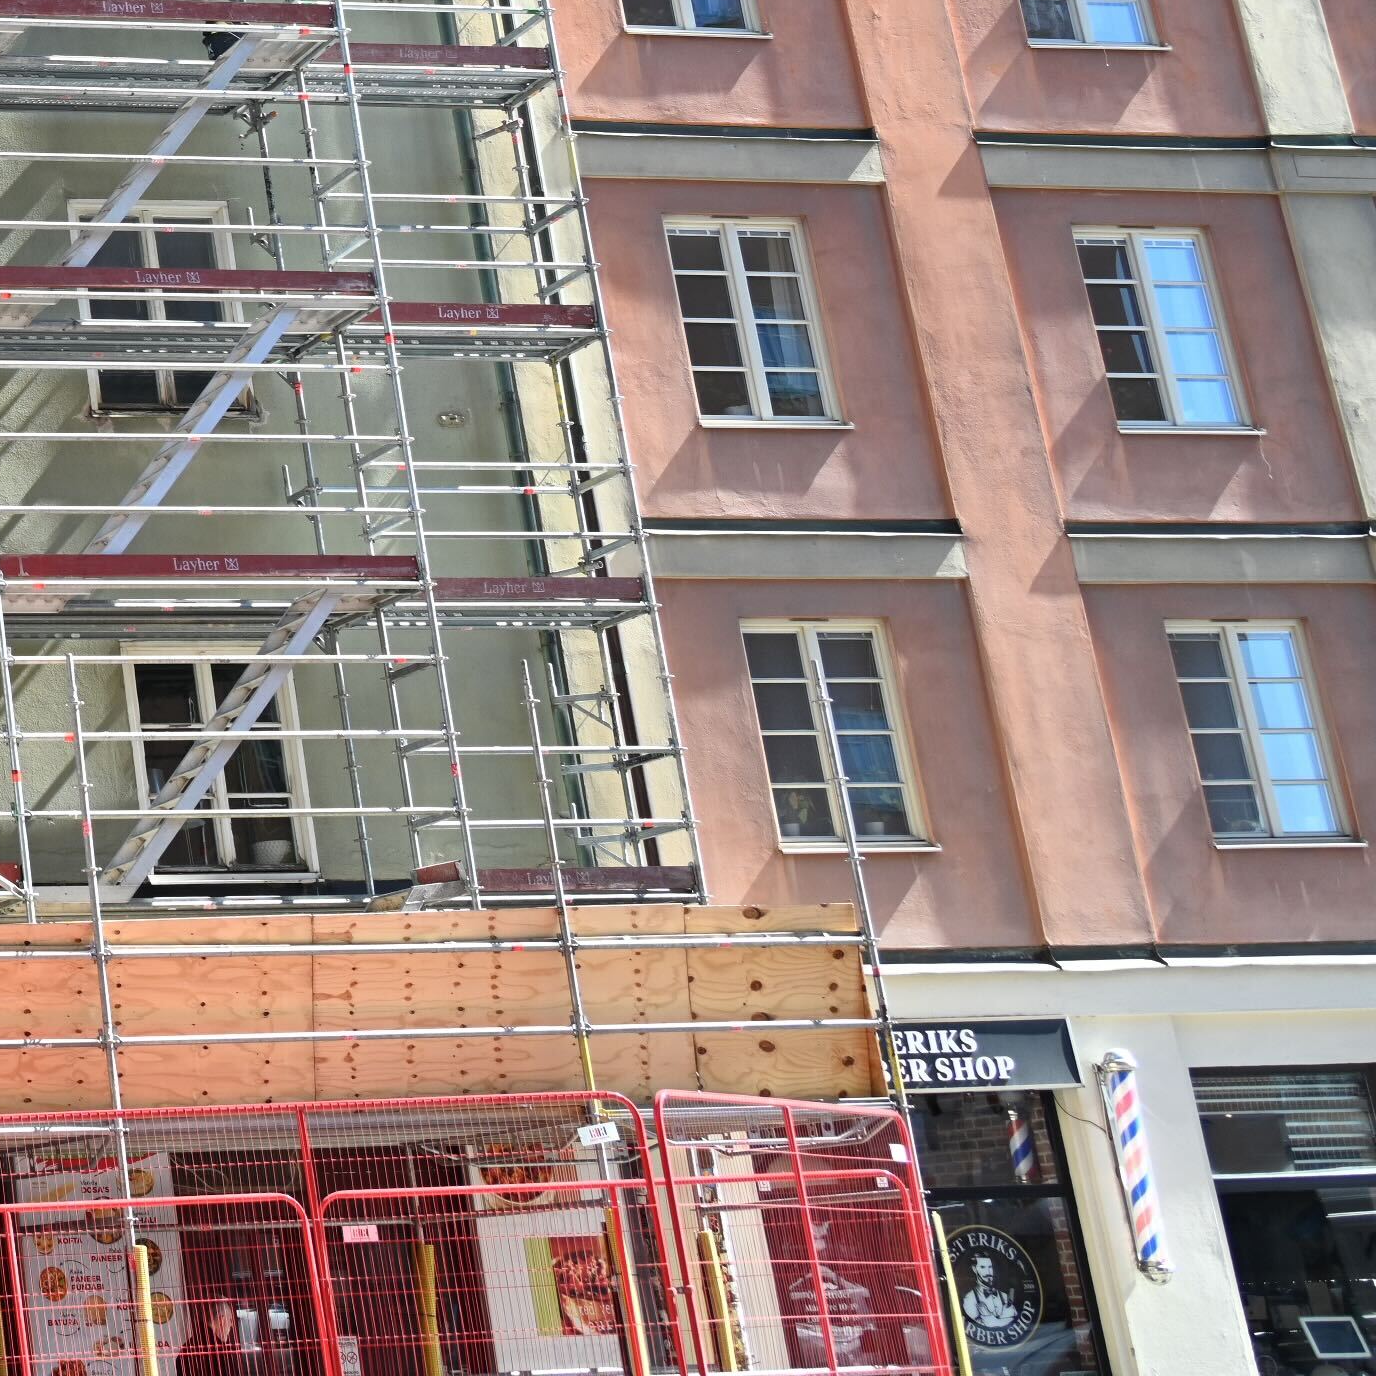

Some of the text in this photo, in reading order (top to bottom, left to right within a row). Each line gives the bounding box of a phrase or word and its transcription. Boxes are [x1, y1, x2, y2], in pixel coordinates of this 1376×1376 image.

[102, 0, 145, 14] Layher
[136, 269, 180, 284] Layher
[438, 305, 481, 320] Layher
[173, 557, 219, 573] Layher
[484, 580, 525, 595] Layher
[935, 1056, 1015, 1081] SHOP
[967, 1232, 1017, 1261] ERIKS
[1008, 1300, 1035, 1340] SHOP
